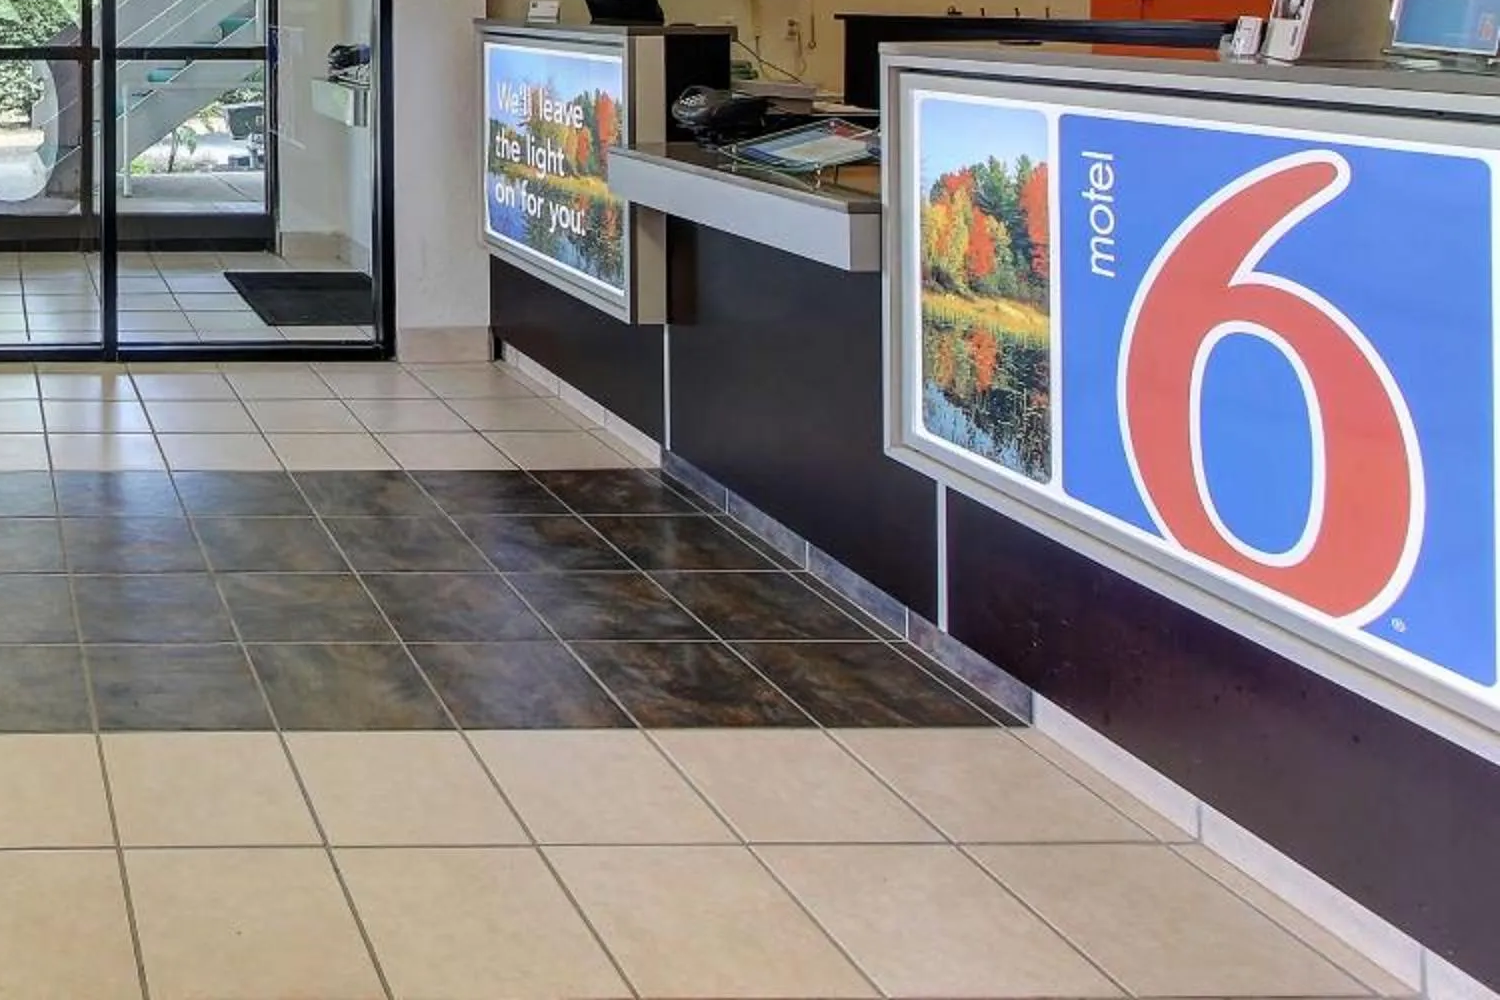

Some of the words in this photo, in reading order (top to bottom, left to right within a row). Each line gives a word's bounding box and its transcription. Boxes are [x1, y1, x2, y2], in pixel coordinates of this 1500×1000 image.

[496, 81, 532, 120] We'll
[539, 86, 584, 129] leave
[495, 128, 521, 163] the
[526, 133, 565, 178] light
[495, 183, 515, 208] on
[520, 180, 544, 218] for
[1080, 151, 1116, 278] motel
[1116, 147, 1427, 630] 6
